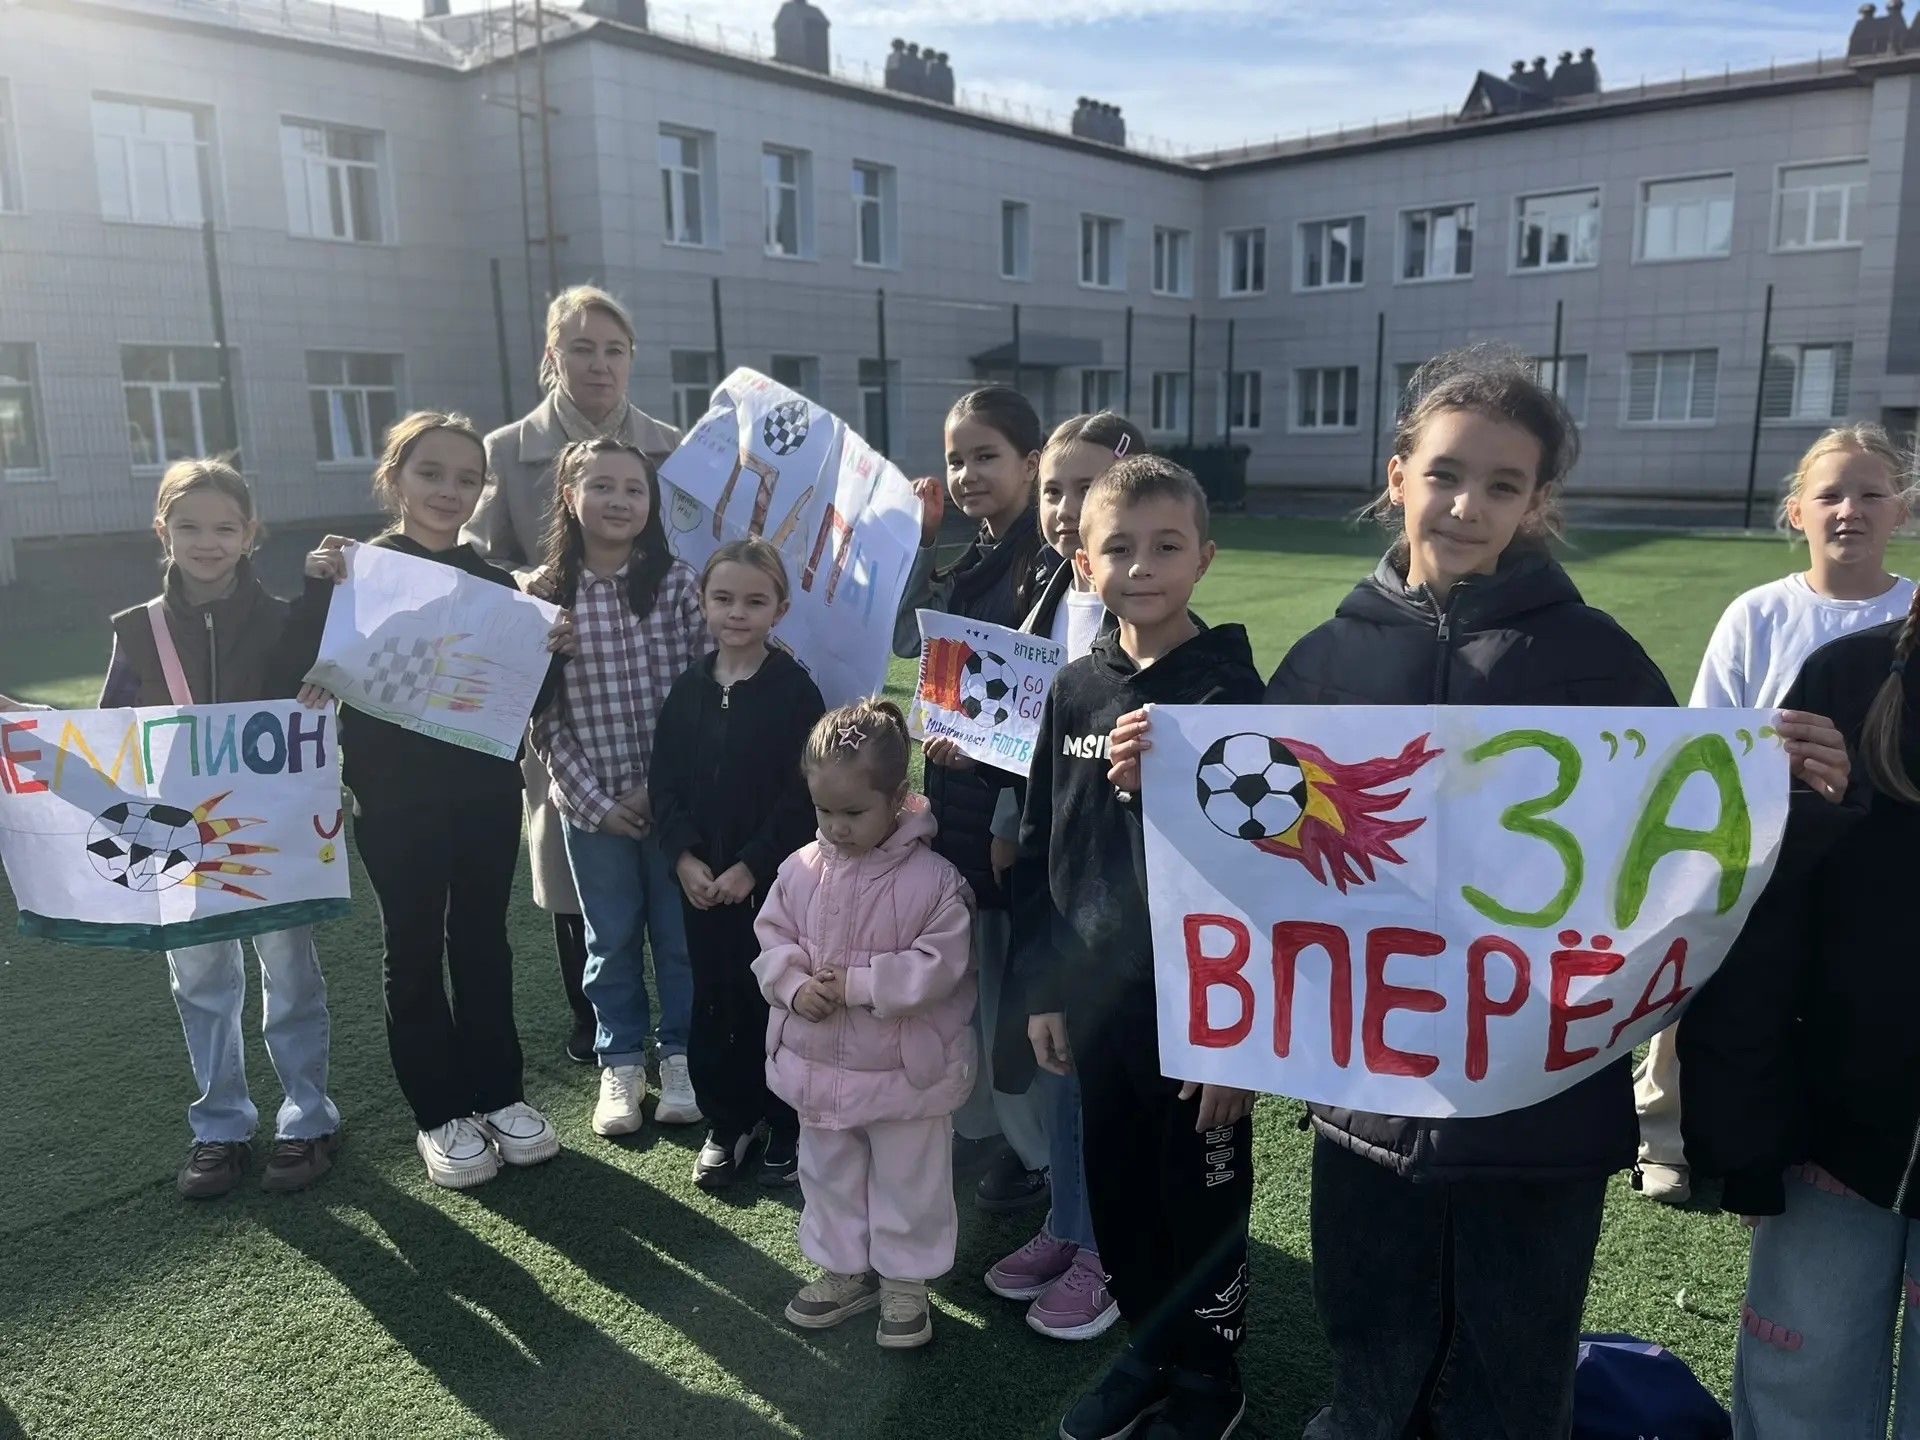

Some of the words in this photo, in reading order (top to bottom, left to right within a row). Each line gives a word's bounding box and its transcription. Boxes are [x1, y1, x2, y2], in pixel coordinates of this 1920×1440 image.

[1014, 642, 1060, 666] ВПЕРЁД!
[1023, 675, 1044, 694] GO
[1019, 696, 1043, 719] GO
[0, 711, 327, 795] ЕМПИОН
[1182, 913, 1693, 1082] ВПЕРЁД
